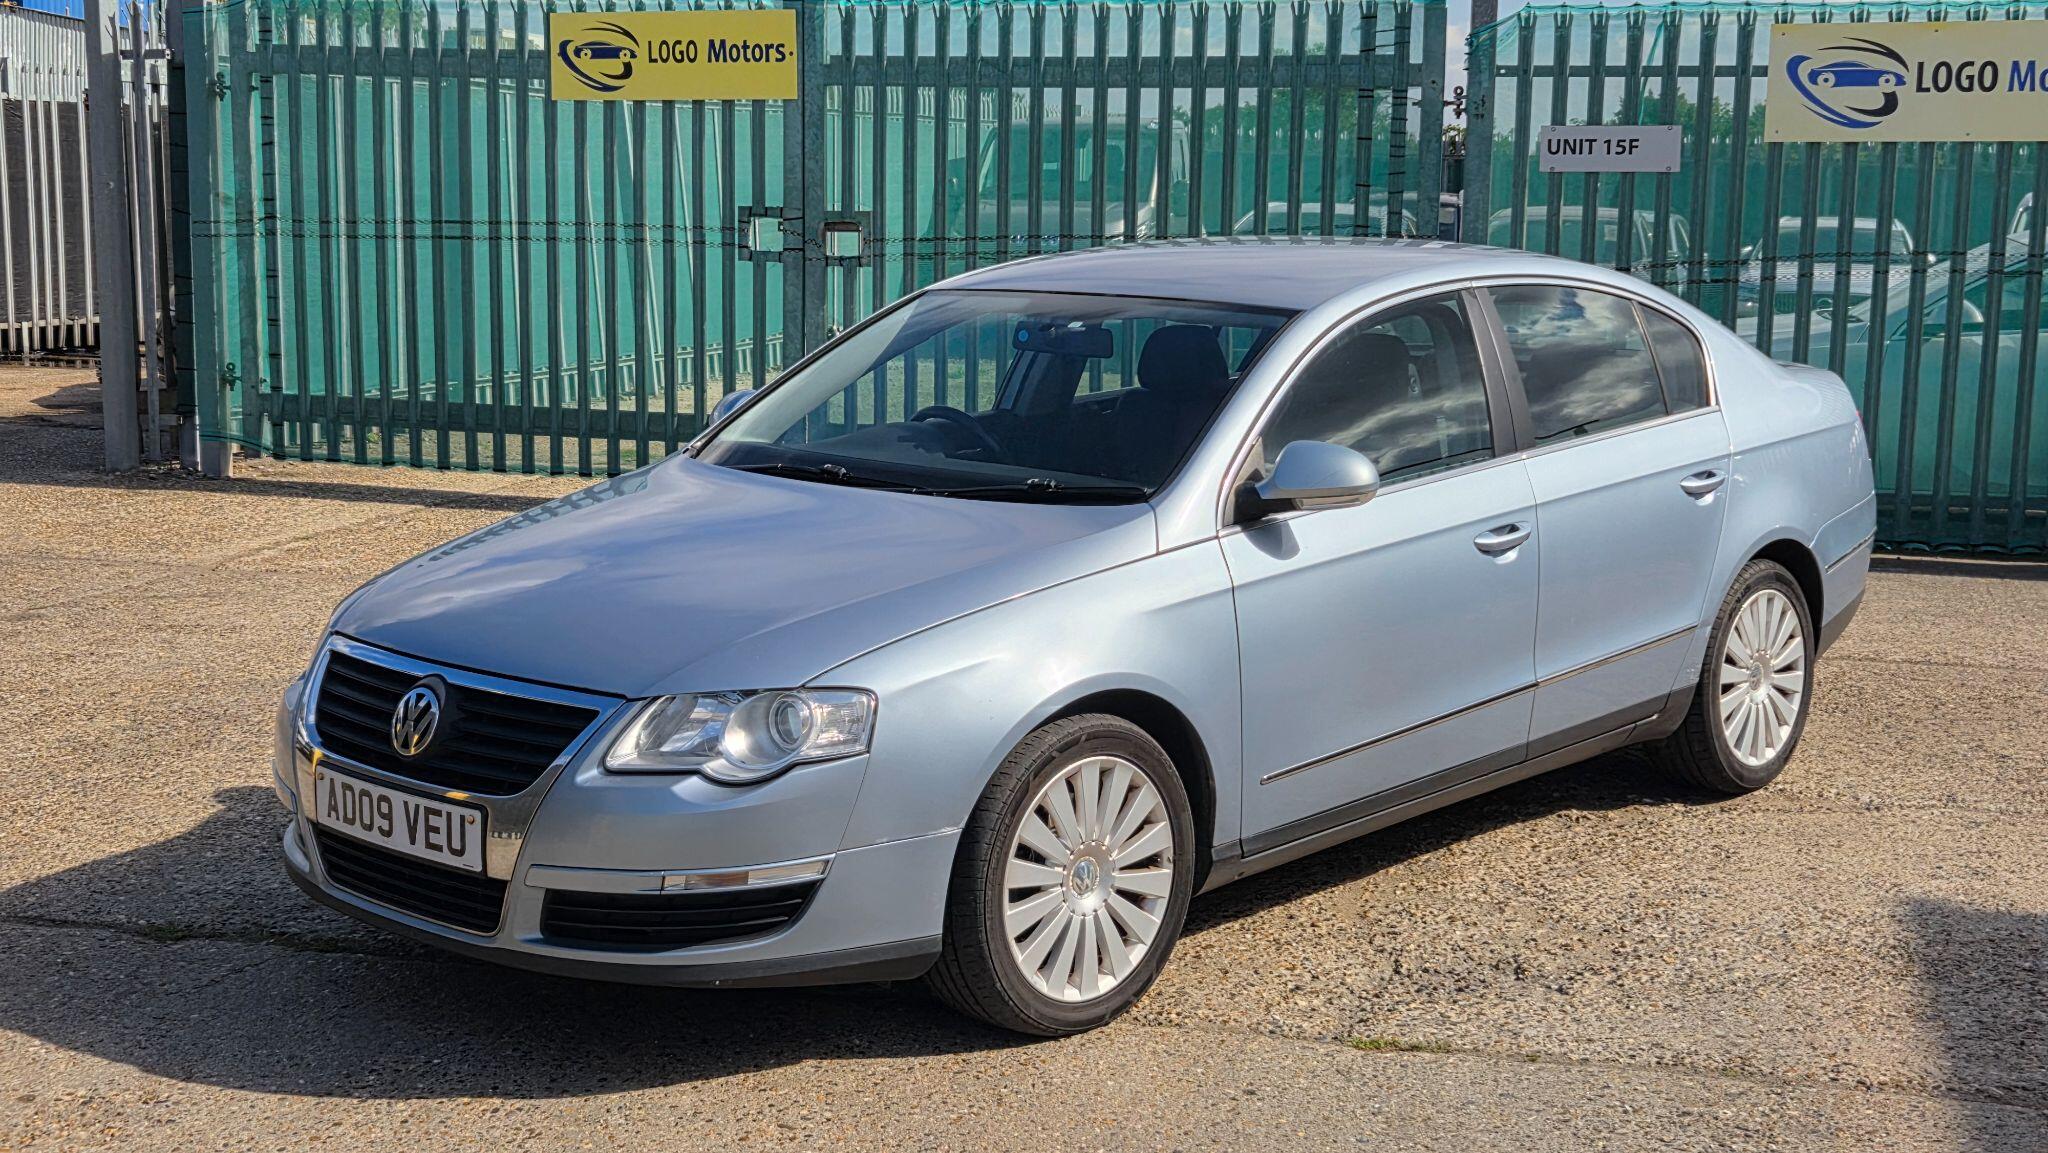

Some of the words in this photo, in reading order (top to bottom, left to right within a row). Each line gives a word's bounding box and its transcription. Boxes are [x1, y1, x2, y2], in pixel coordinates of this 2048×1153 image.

[648, 40, 698, 63] LOGO
[707, 38, 786, 63] Motors
[1915, 60, 1999, 93] LOGO
[1547, 138, 1598, 155] UNIT
[1603, 138, 1640, 155] 15F
[327, 777, 394, 839] AD09
[403, 800, 467, 857] VEU
